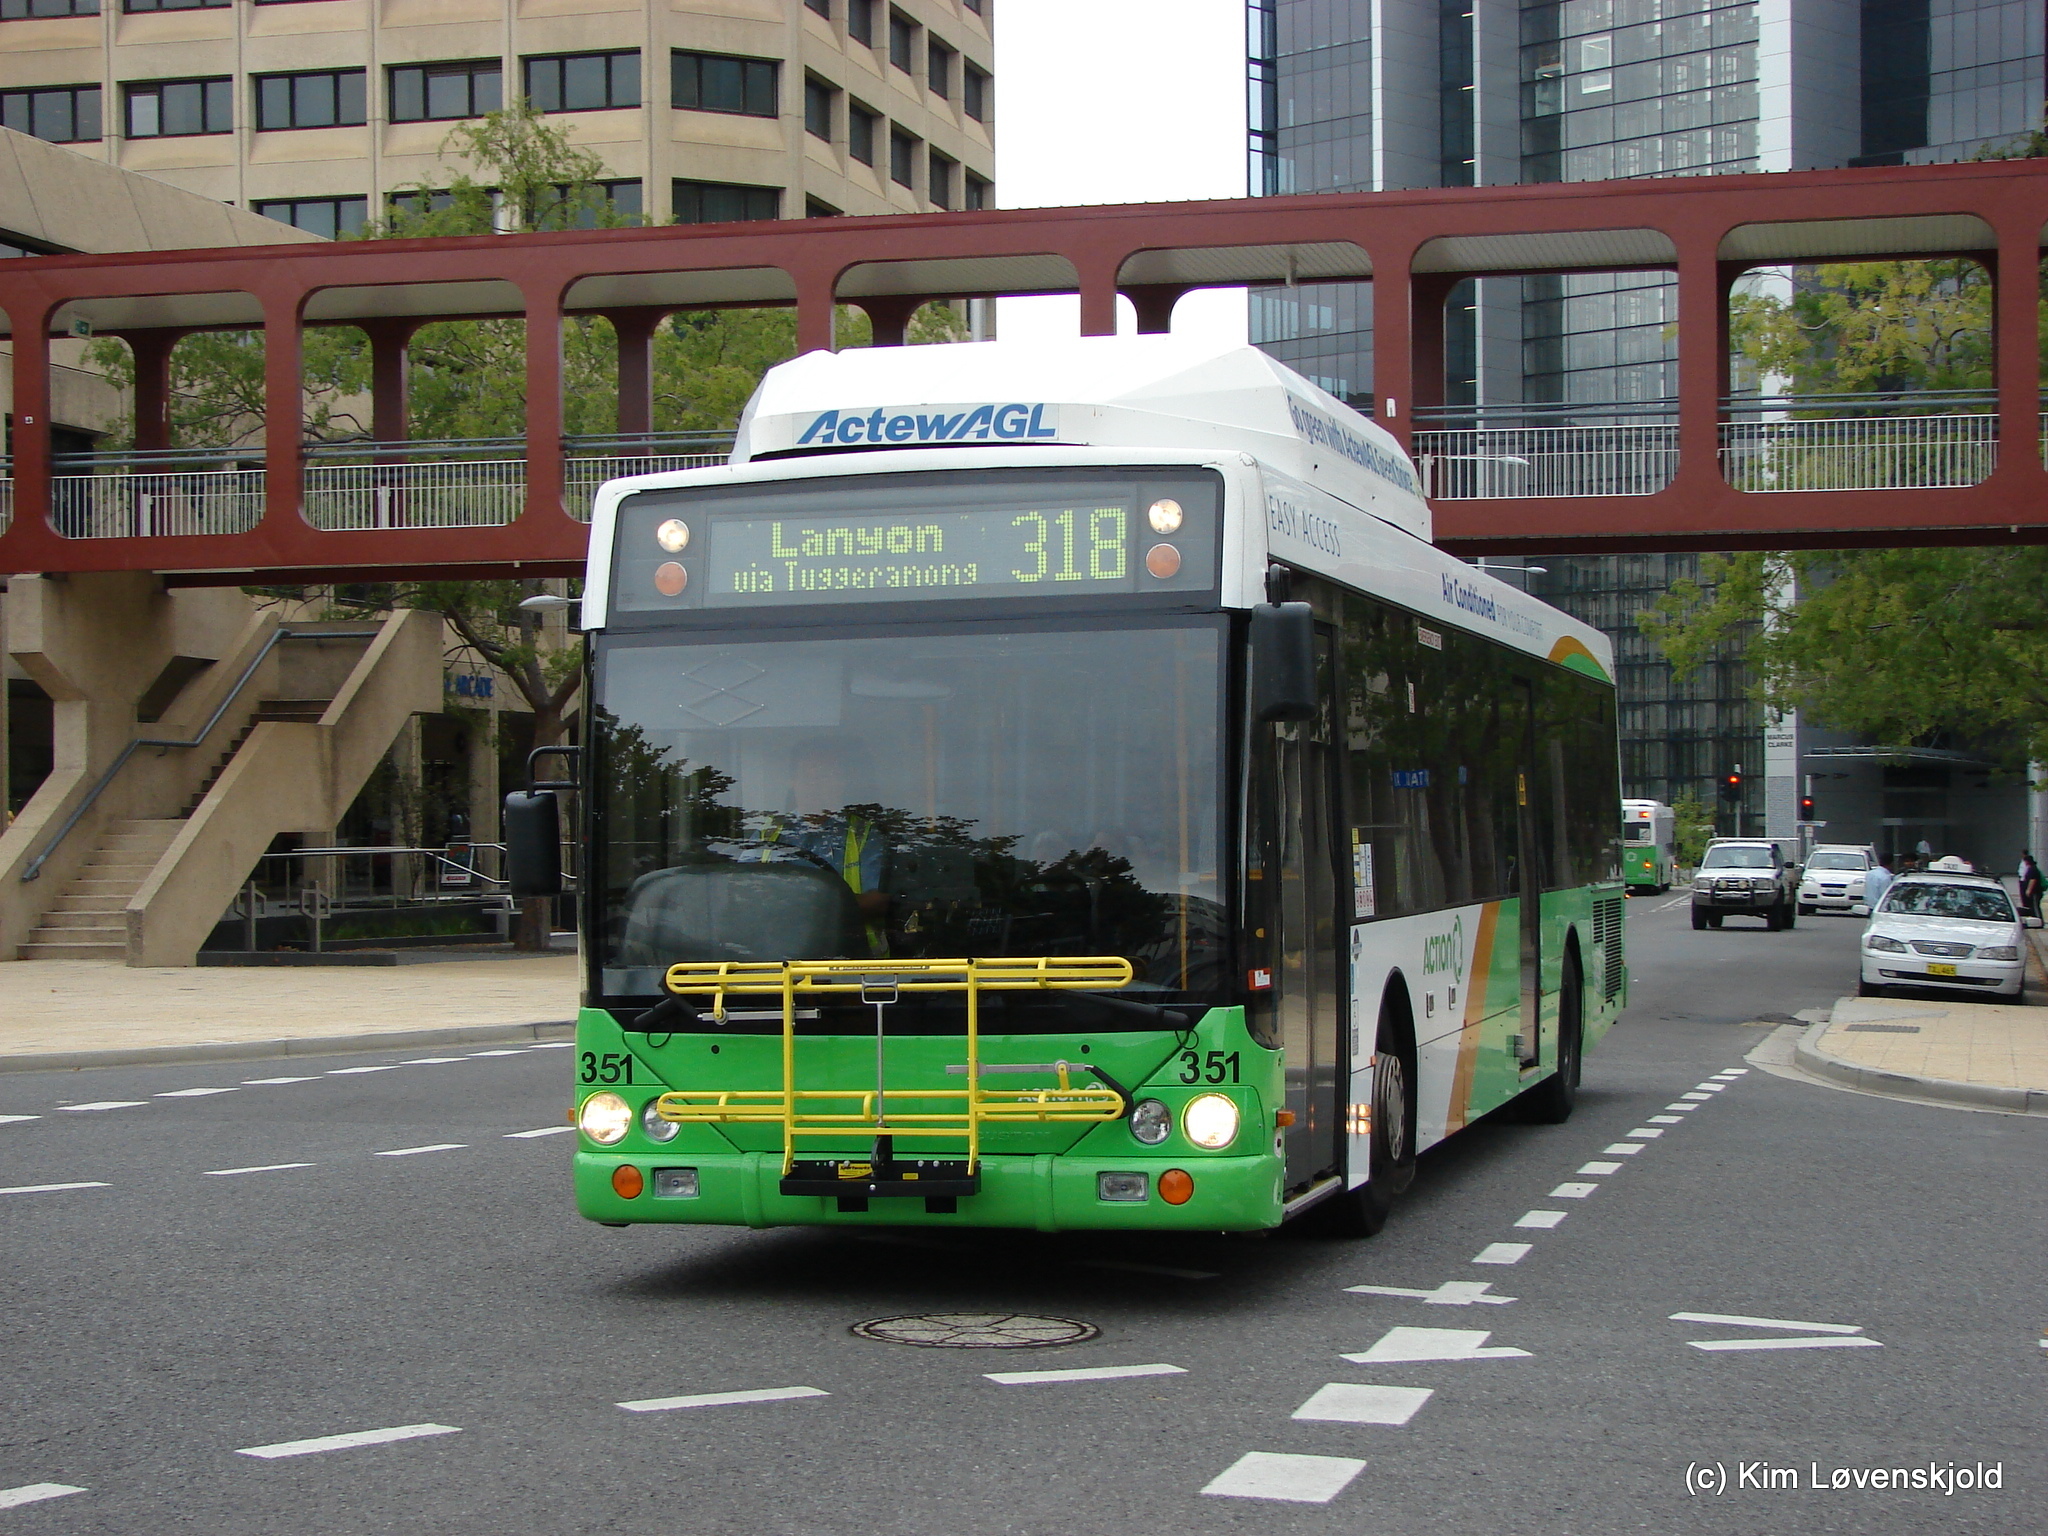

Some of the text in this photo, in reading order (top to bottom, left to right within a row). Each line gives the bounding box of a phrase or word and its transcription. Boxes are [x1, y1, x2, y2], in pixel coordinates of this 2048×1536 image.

[797, 403, 1058, 445] ActewAGL
[772, 508, 1127, 584] Lanyon 318
[1269, 494, 1341, 557] EASY ACCESS
[735, 560, 978, 593] via Tuggeranong
[1441, 573, 1454, 604] Air
[1454, 578, 1496, 621] Conditioned
[1423, 933, 1452, 975] ACTION
[581, 1052, 632, 1086] 351
[1179, 1052, 1241, 1086] 351
